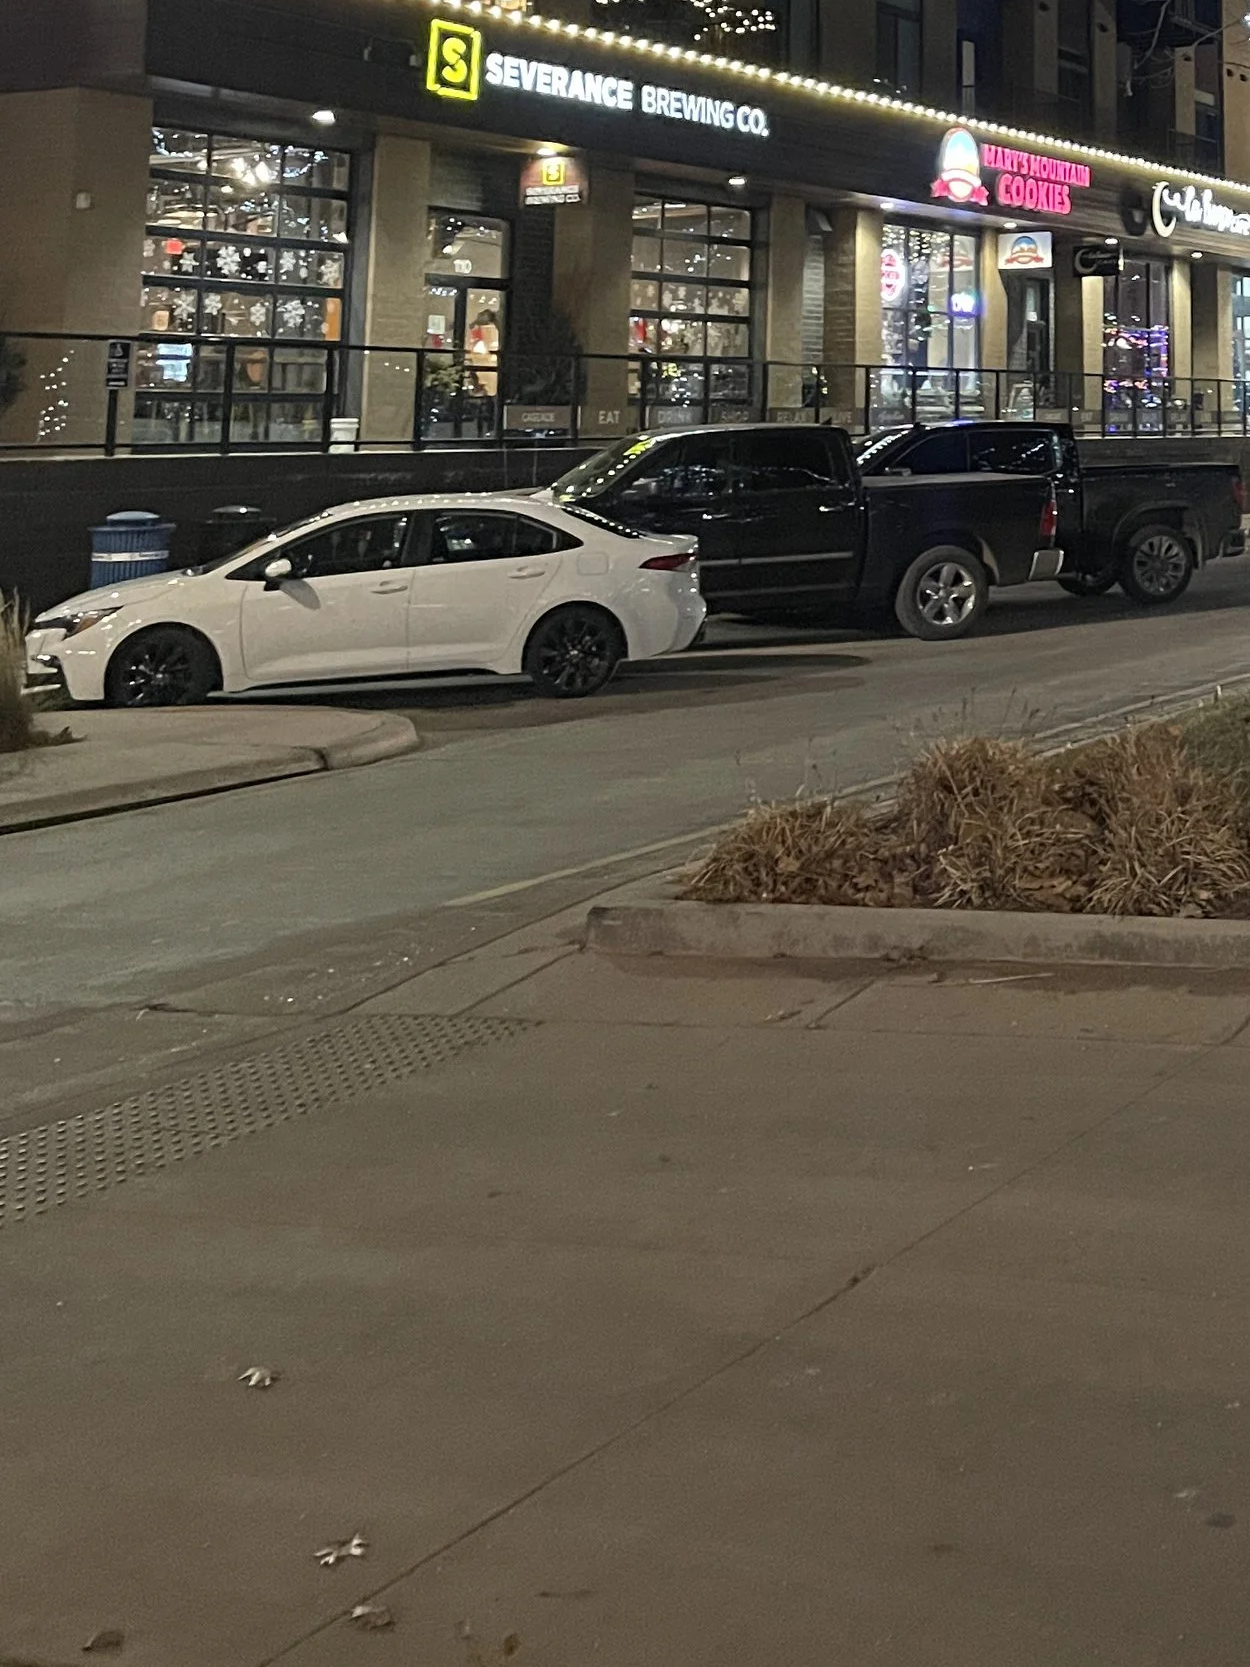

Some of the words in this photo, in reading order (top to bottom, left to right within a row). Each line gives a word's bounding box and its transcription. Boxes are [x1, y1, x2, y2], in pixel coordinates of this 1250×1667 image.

[485, 52, 634, 111] SEVERANCE
[641, 84, 734, 129] BREWING
[736, 105, 770, 137] CO.
[981, 143, 1029, 175] MARY'S
[1030, 153, 1090, 188] MOUNTAIN
[996, 172, 1071, 215] COOKIES
[598, 410, 620, 424] EAT
[657, 410, 692, 424] DRINK
